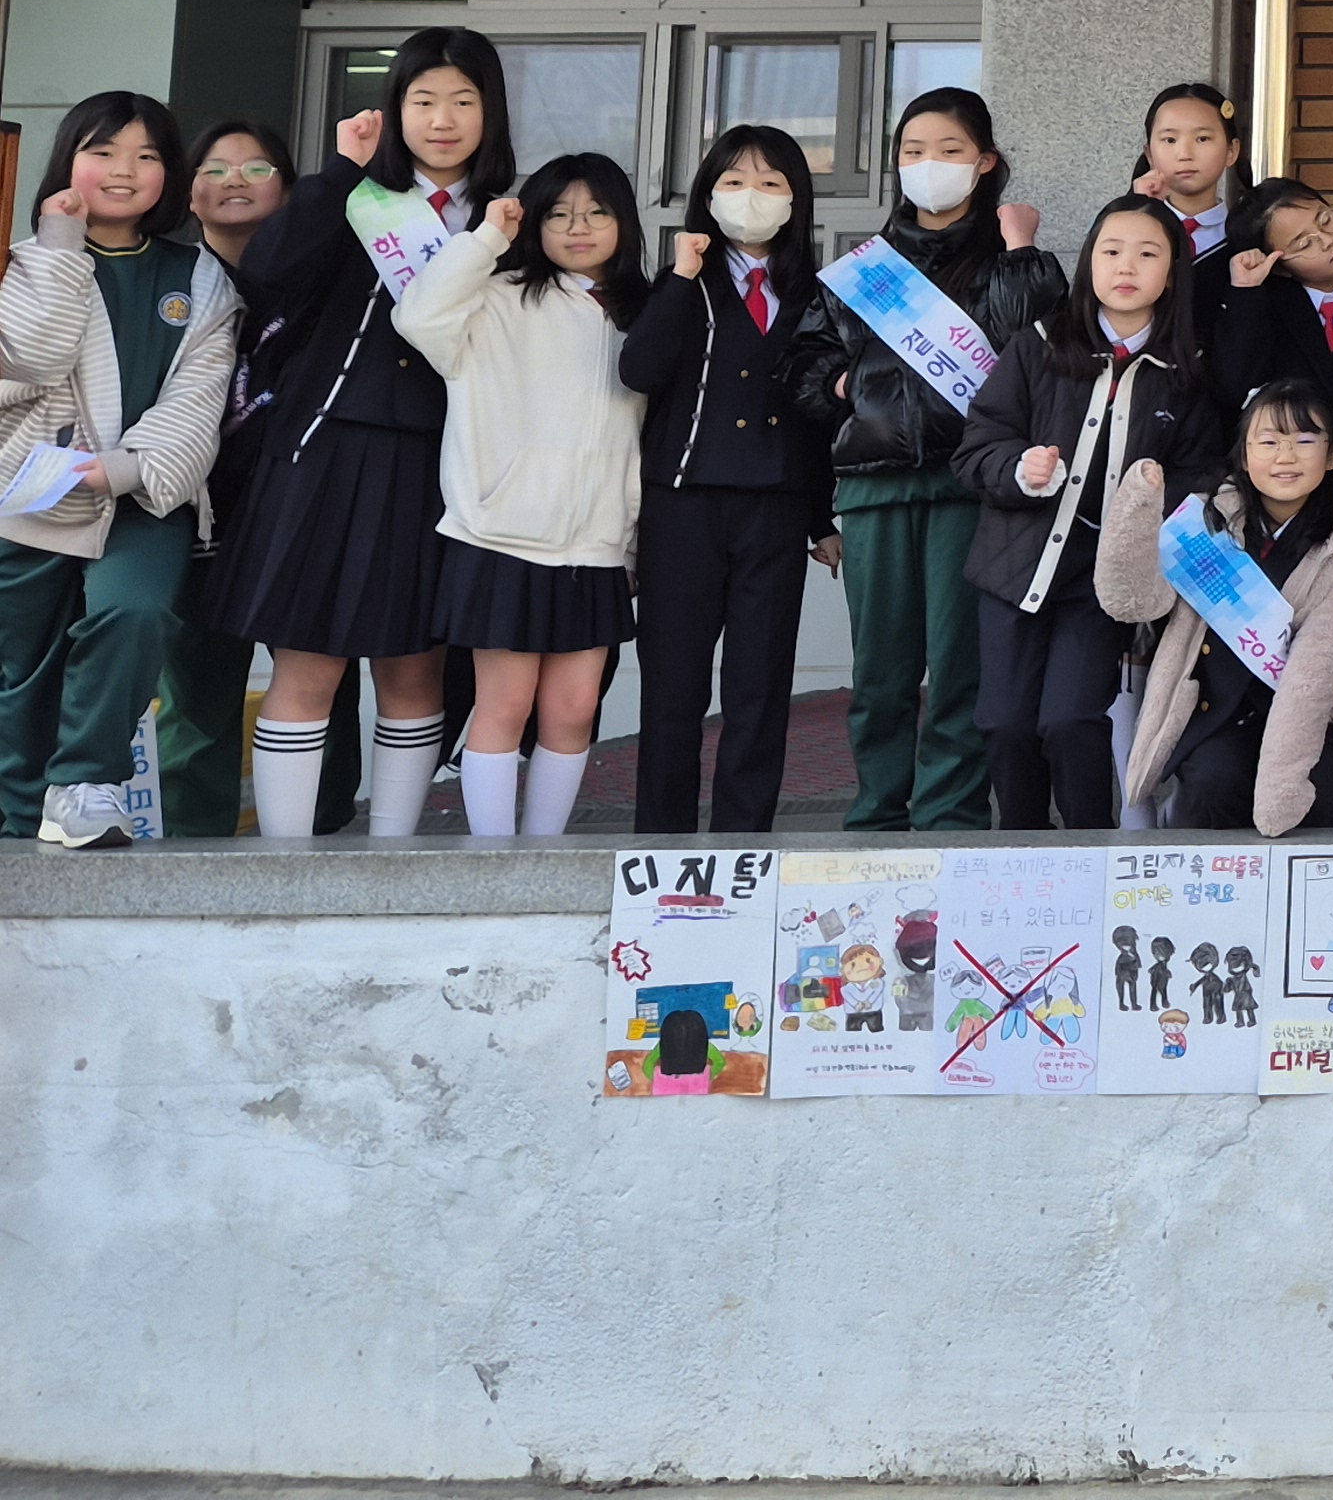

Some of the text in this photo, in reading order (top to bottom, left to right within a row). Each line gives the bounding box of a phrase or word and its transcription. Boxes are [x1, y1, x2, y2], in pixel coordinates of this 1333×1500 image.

[900, 328, 960, 377] 곁에
[621, 853, 773, 899] 디지털
[953, 857, 989, 878] 살짝
[1064, 857, 1093, 873] 해도
[1115, 853, 1186, 880] 그림자
[1190, 854, 1204, 878] 속
[1114, 884, 1173, 909] 이제는
[951, 910, 966, 928] 이
[1025, 907, 1093, 927] 있습니다
[1270, 1049, 1333, 1073] 디지털
